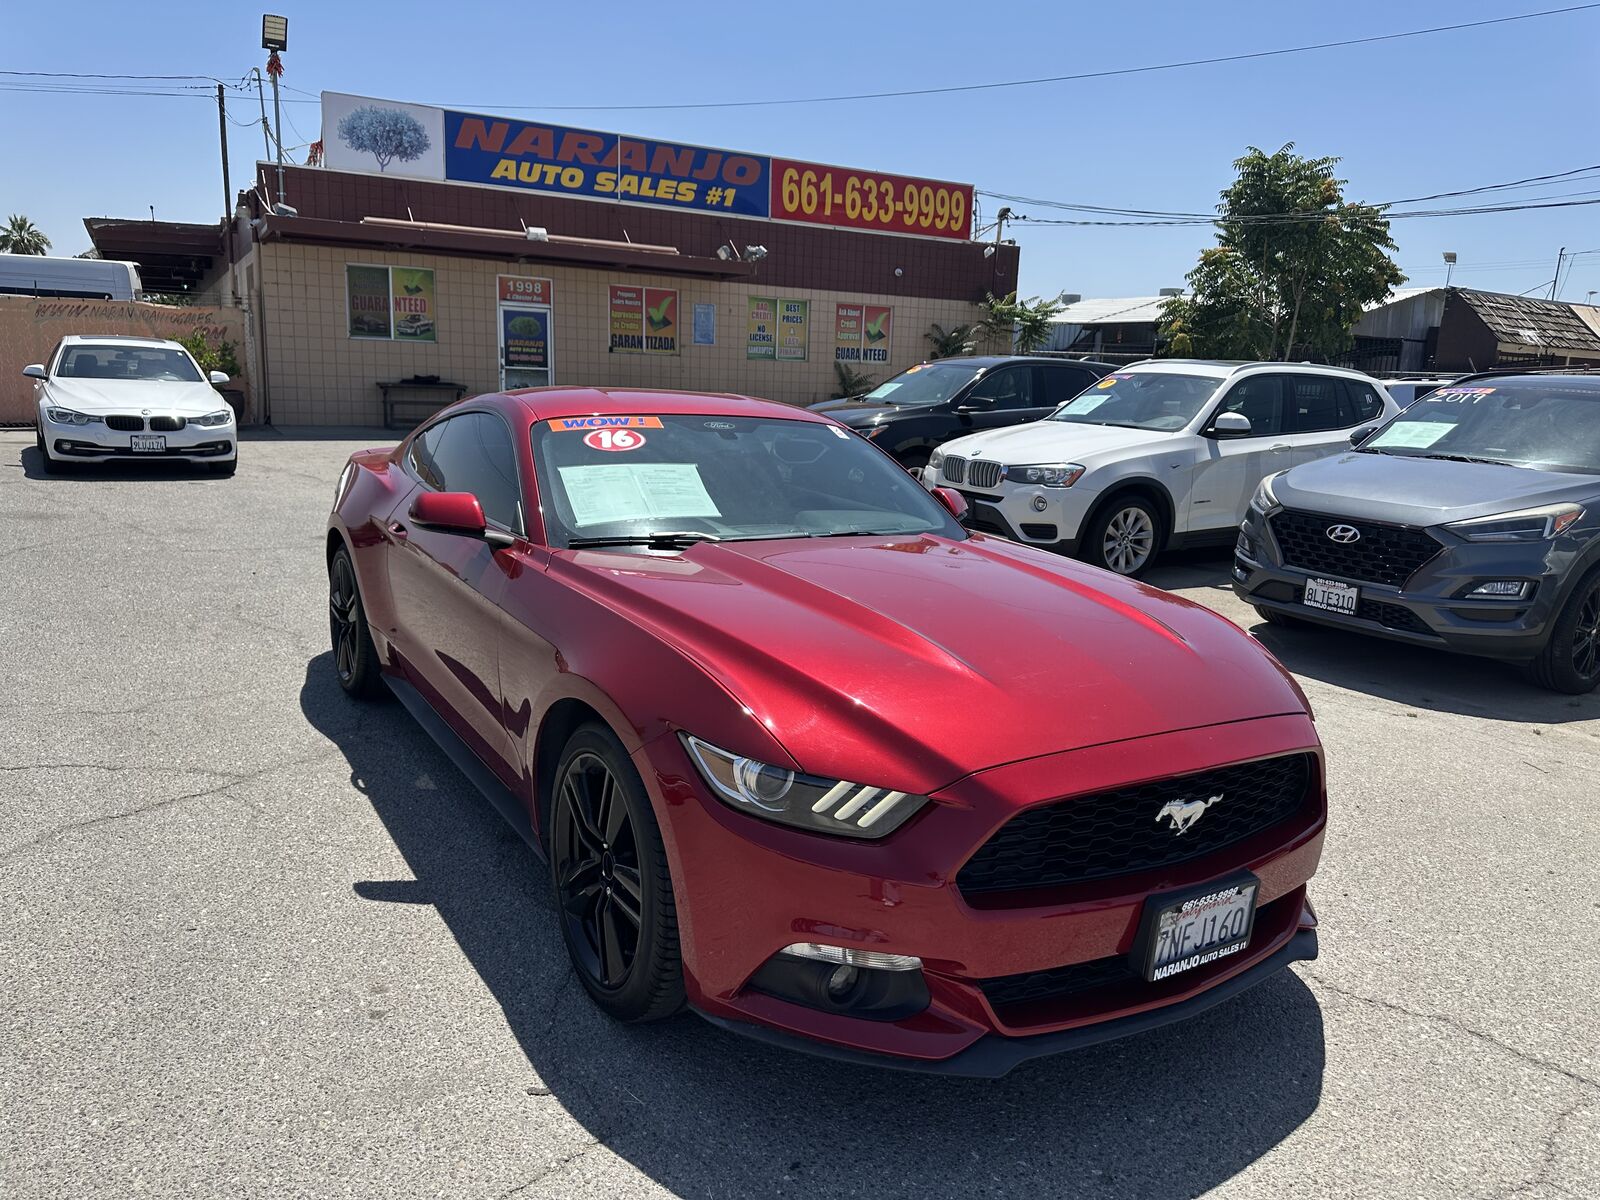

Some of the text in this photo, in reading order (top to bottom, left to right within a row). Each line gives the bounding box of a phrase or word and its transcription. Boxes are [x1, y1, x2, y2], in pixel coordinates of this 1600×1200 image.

[455, 118, 762, 187] NARANJO
[490, 158, 736, 207] AUTO SALES #1
[782, 167, 965, 232] 661-633-9999
[507, 280, 542, 294] 1998
[352, 295, 427, 313] GUARANTEED
[785, 304, 800, 313] BEST
[782, 314, 803, 324] PRICES
[757, 324, 766, 333] NO
[611, 333, 676, 351] GARANTIZADA
[749, 333, 773, 343] LICENSE
[835, 347, 888, 361] GUARANTEED
[1427, 393, 1487, 404] 2019
[562, 417, 630, 428] WOW
[598, 430, 634, 448] 16
[1306, 587, 1354, 611] 8LTE310
[1181, 886, 1239, 912] 661-633-9999
[1153, 954, 1200, 981] NARANJO
[1199, 950, 1218, 965] AUTO
[1218, 943, 1239, 957] SALES
